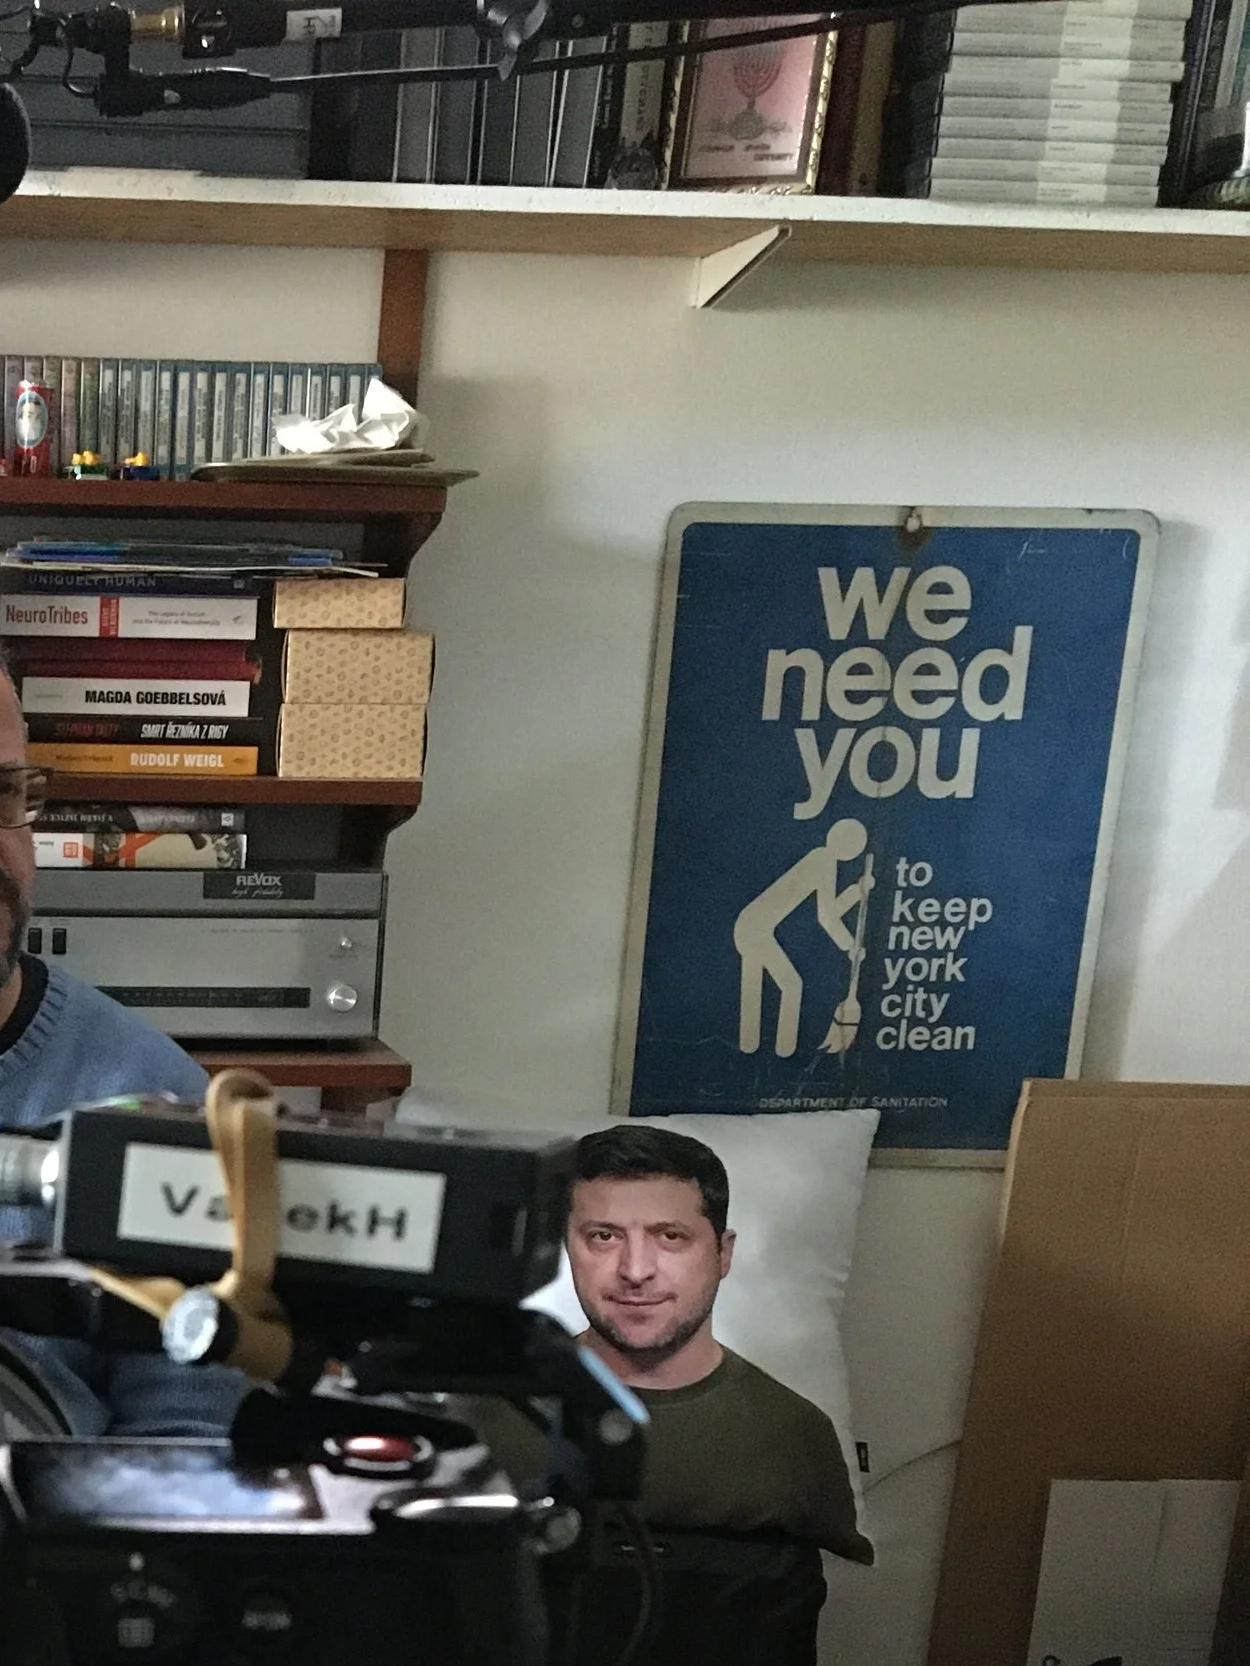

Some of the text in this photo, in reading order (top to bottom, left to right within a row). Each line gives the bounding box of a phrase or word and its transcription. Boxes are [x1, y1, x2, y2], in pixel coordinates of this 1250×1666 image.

[105, 575, 158, 588] HUMAN
[6, 604, 89, 626] NeuroTribes
[817, 564, 972, 641] we
[761, 625, 1034, 722] need
[85, 689, 227, 706] MAGDA GOEBBELSOVÁ
[140, 721, 229, 740] SMRT ŘEZNÍKA Z RIGY
[130, 752, 180, 767] RUDOLF
[184, 753, 225, 768] WEIGL
[793, 727, 980, 820] you
[896, 856, 933, 887] to
[892, 891, 993, 930] keep
[887, 924, 966, 950] new
[882, 953, 966, 989] york
[880, 992, 950, 1021] city
[875, 1022, 976, 1051] clean
